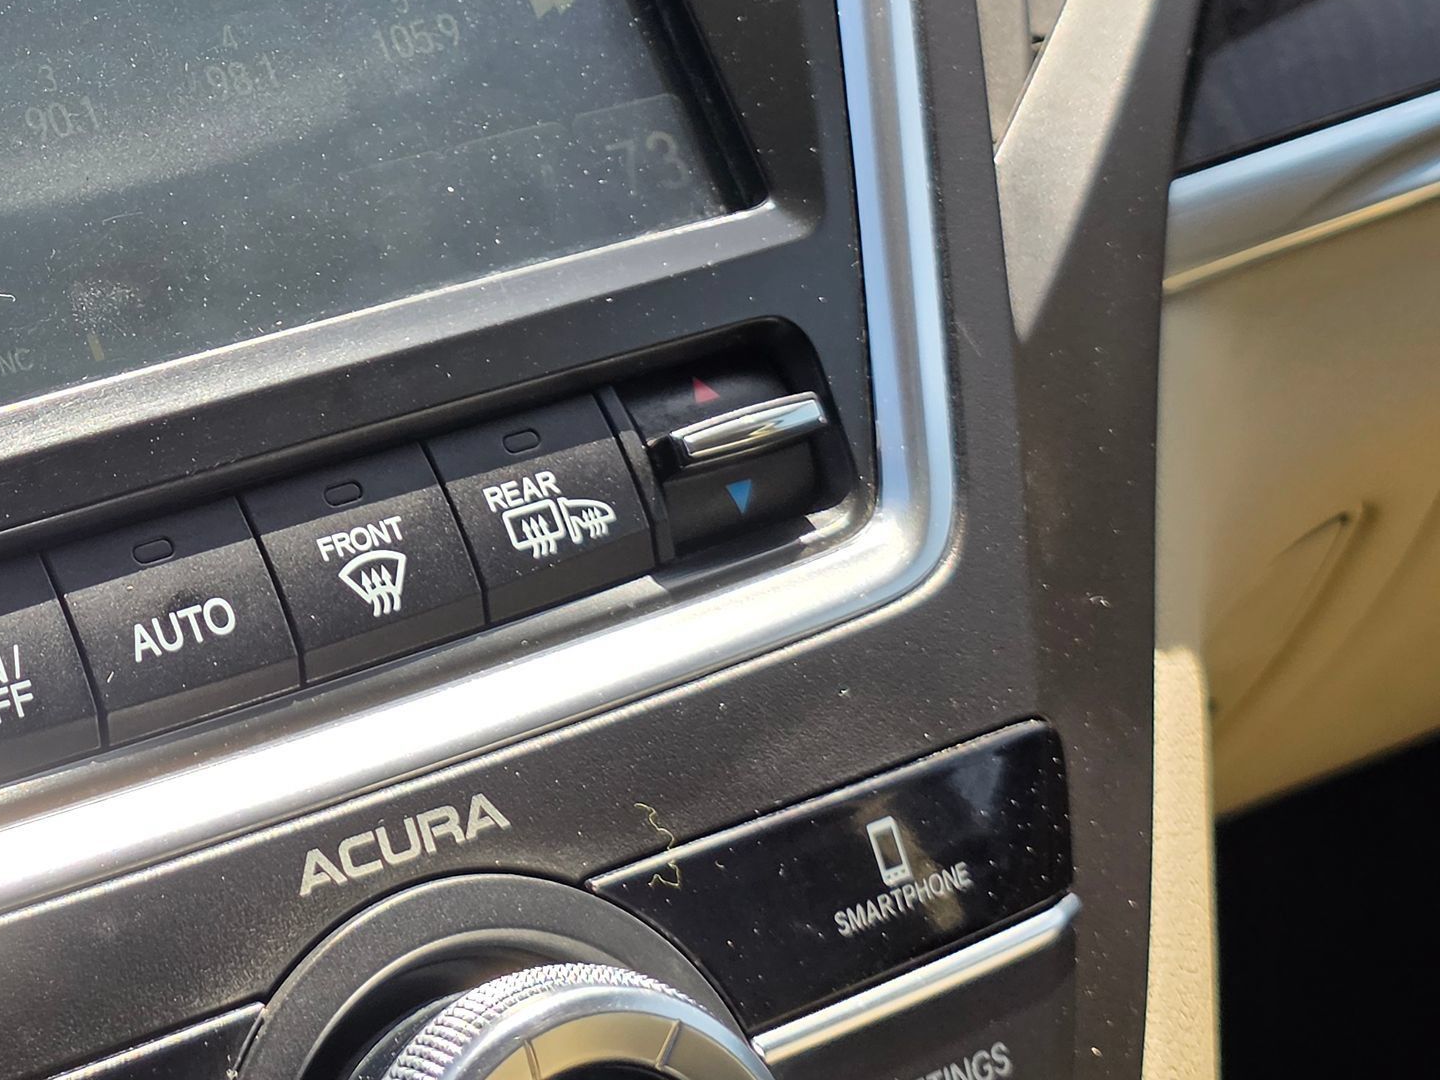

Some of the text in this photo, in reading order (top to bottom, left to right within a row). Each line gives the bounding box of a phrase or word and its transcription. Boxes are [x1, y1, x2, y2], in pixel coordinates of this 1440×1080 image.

[603, 129, 693, 199] 73
[483, 470, 562, 512] REAR
[316, 515, 403, 563] FRONT
[132, 596, 237, 663] AUTO
[298, 792, 512, 897] ACURA
[833, 861, 976, 939] SMARTPHONE
